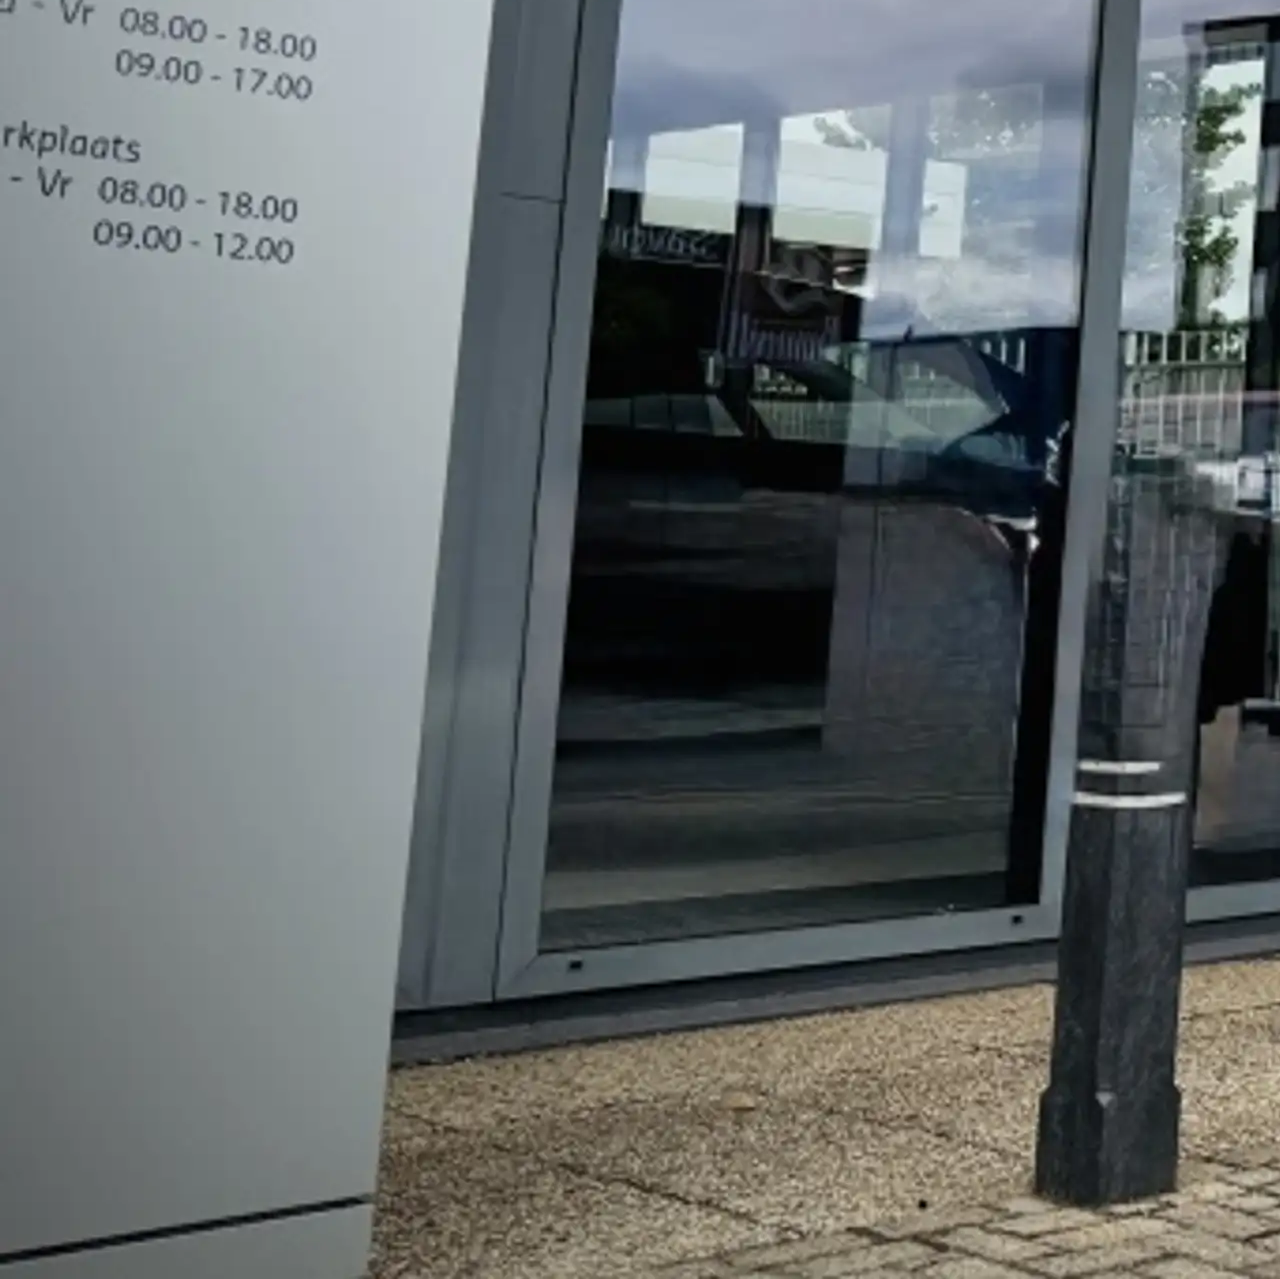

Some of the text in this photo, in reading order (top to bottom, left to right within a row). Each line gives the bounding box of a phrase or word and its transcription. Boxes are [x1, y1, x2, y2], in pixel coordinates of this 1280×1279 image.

[120, 7, 208, 44] 08.00
[239, 26, 318, 61] 18.00
[115, 49, 203, 85] 09.00
[234, 67, 314, 101] 17.00
[2, 120, 142, 163] rkplaats
[37, 166, 74, 199] Vr
[98, 176, 188, 212] 08.00
[218, 191, 299, 223] 18.00
[93, 219, 183, 253] 09.00
[214, 232, 295, 264] 12.00
